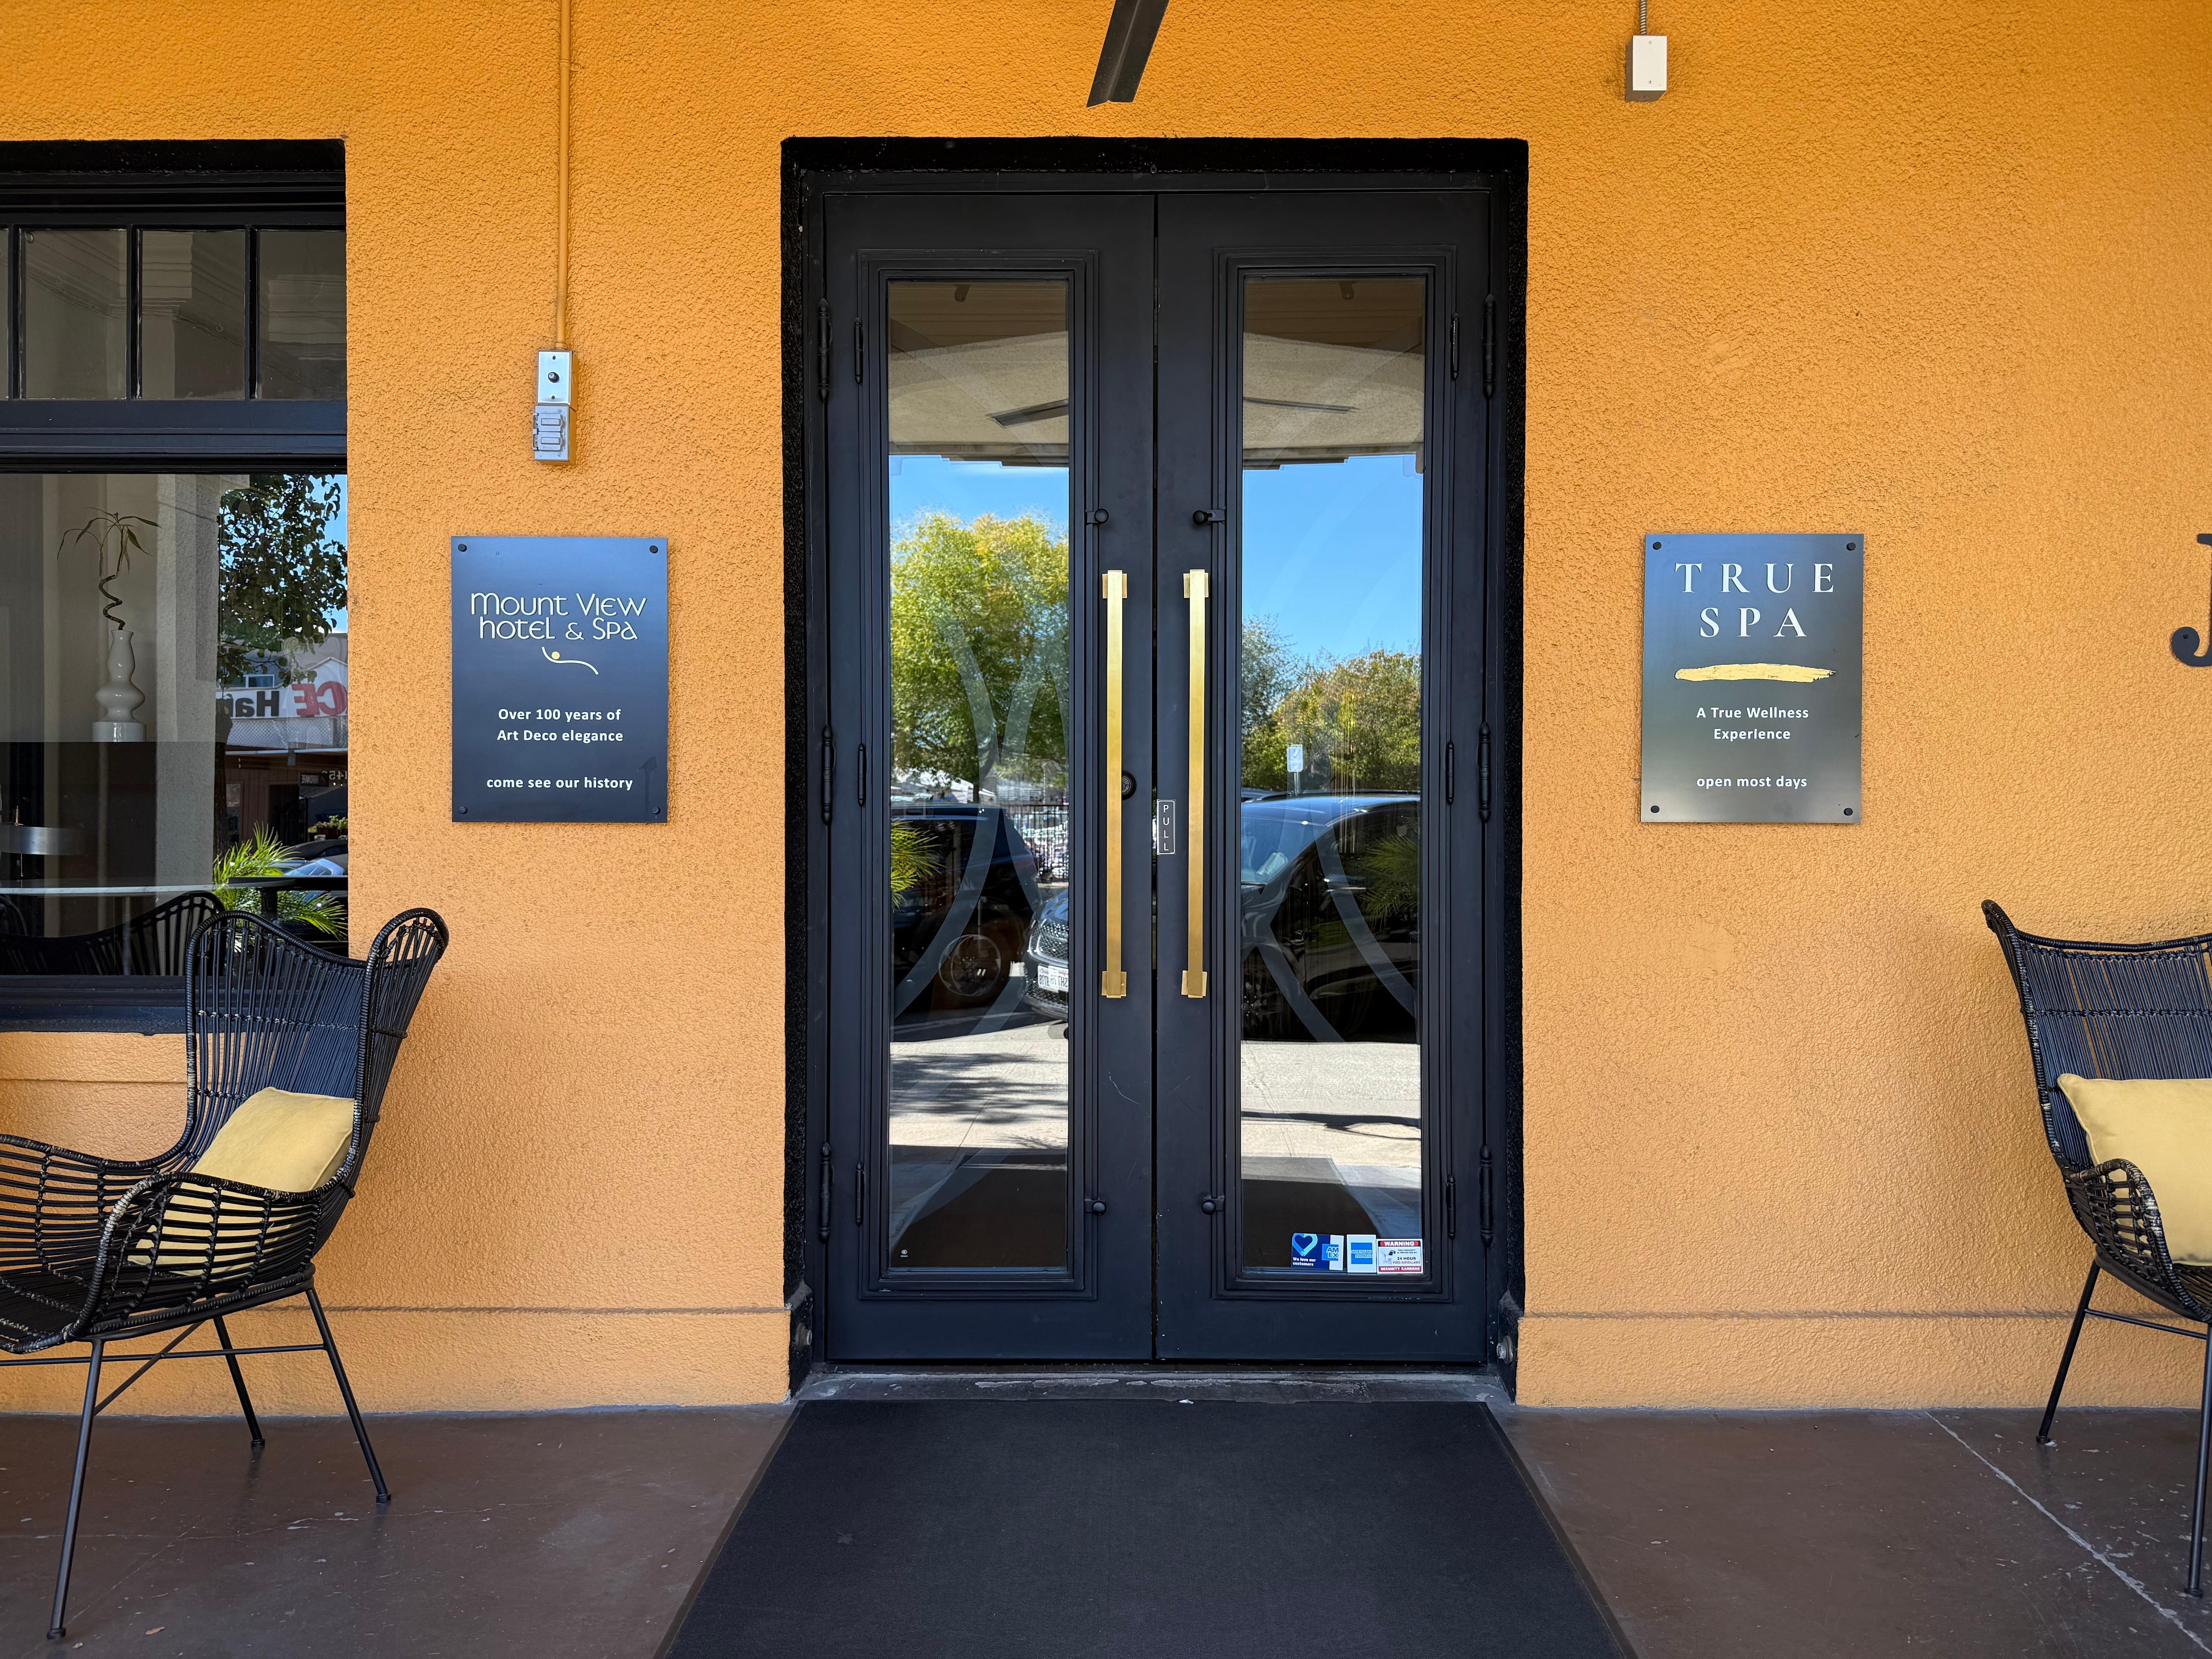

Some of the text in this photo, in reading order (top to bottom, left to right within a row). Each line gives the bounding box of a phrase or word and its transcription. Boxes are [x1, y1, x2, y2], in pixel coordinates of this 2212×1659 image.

[1675, 563, 1834, 593] TRUE
[1700, 607, 1807, 637] SPA
[565, 622, 584, 640] &
[498, 709, 621, 722] Over 100 years of
[1696, 707, 1809, 718] A True Wellness
[497, 730, 623, 744] Art Deco elegance
[1714, 728, 1790, 742] Experience
[487, 776, 633, 791] come see our history
[1697, 776, 1807, 790] open most days
